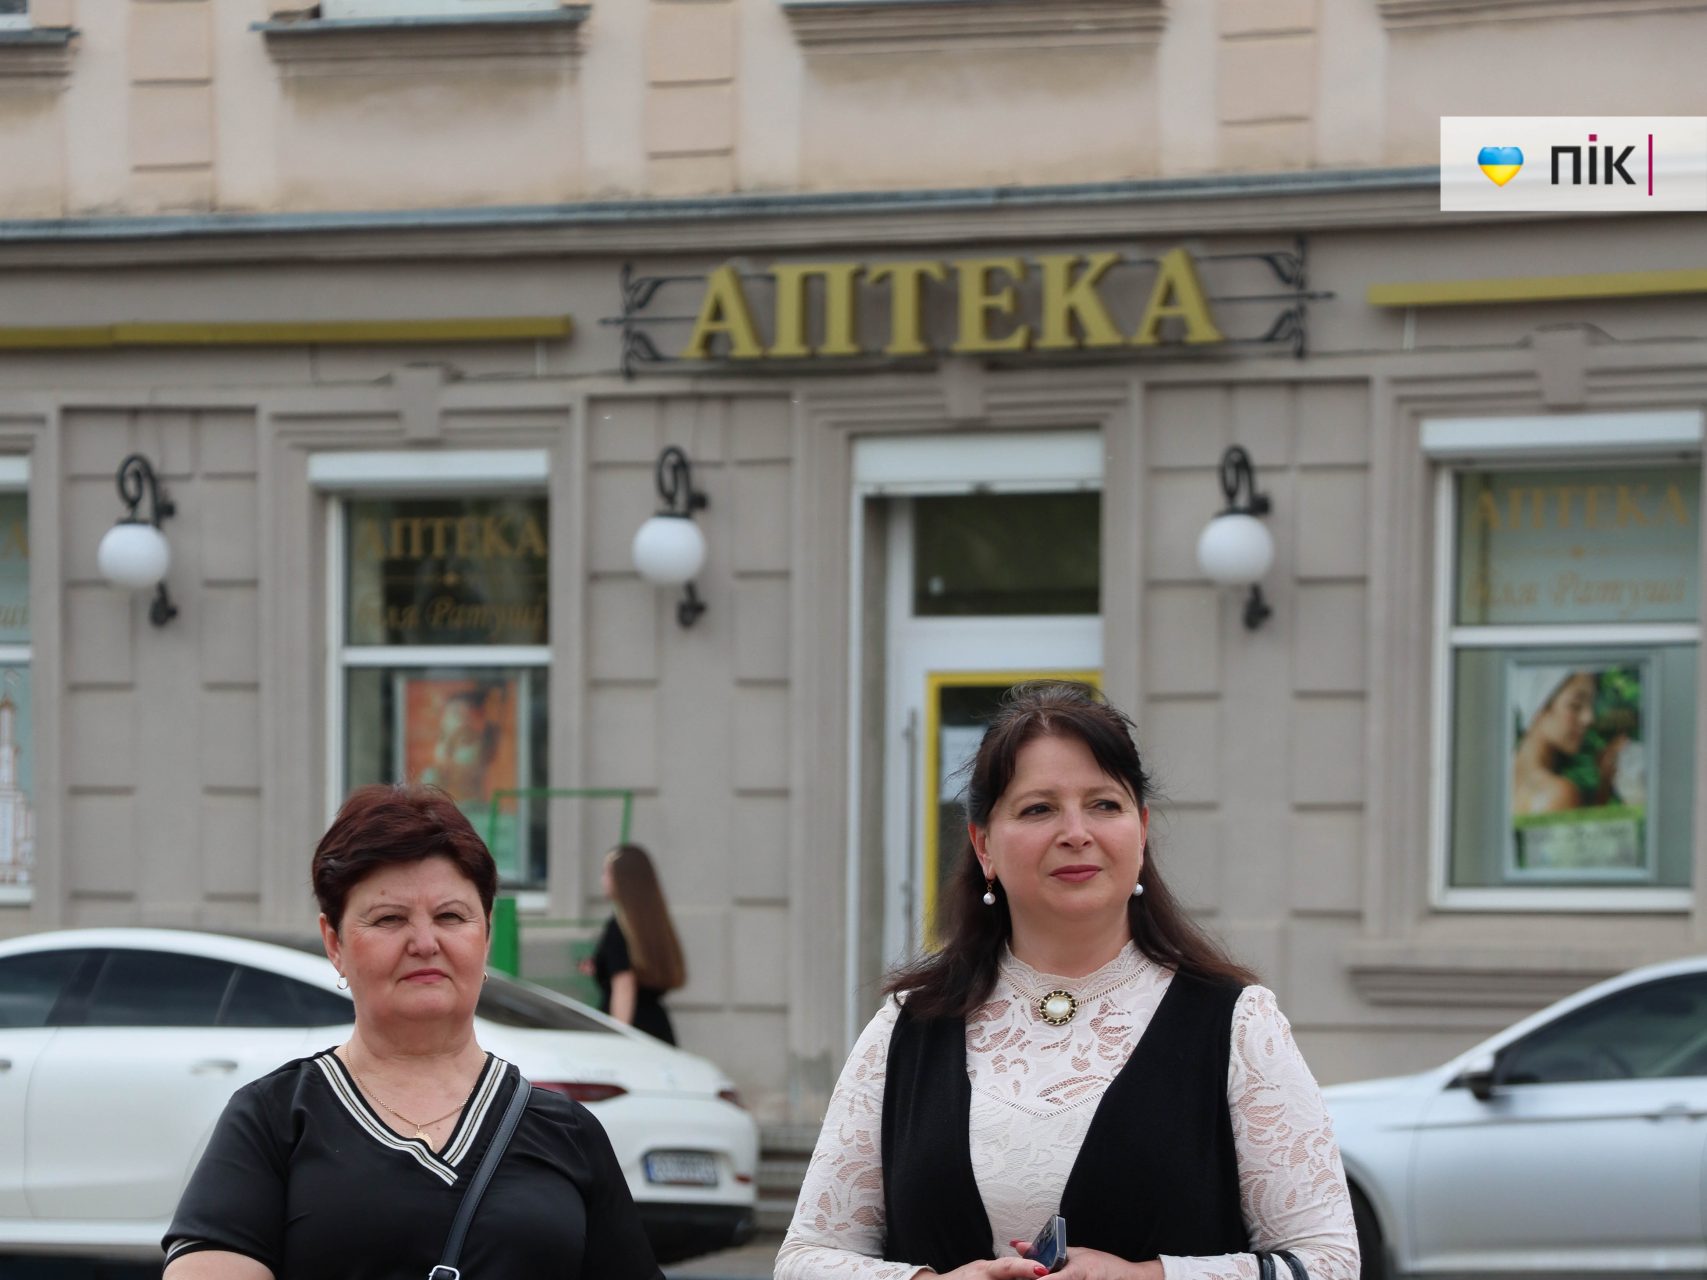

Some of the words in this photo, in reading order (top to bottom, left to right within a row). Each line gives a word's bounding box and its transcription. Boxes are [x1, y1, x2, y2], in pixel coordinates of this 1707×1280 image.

[679, 248, 1224, 359] АПТЕКА
[1472, 482, 1692, 530] АПТЕКА
[355, 516, 548, 559] АПТЕКА
